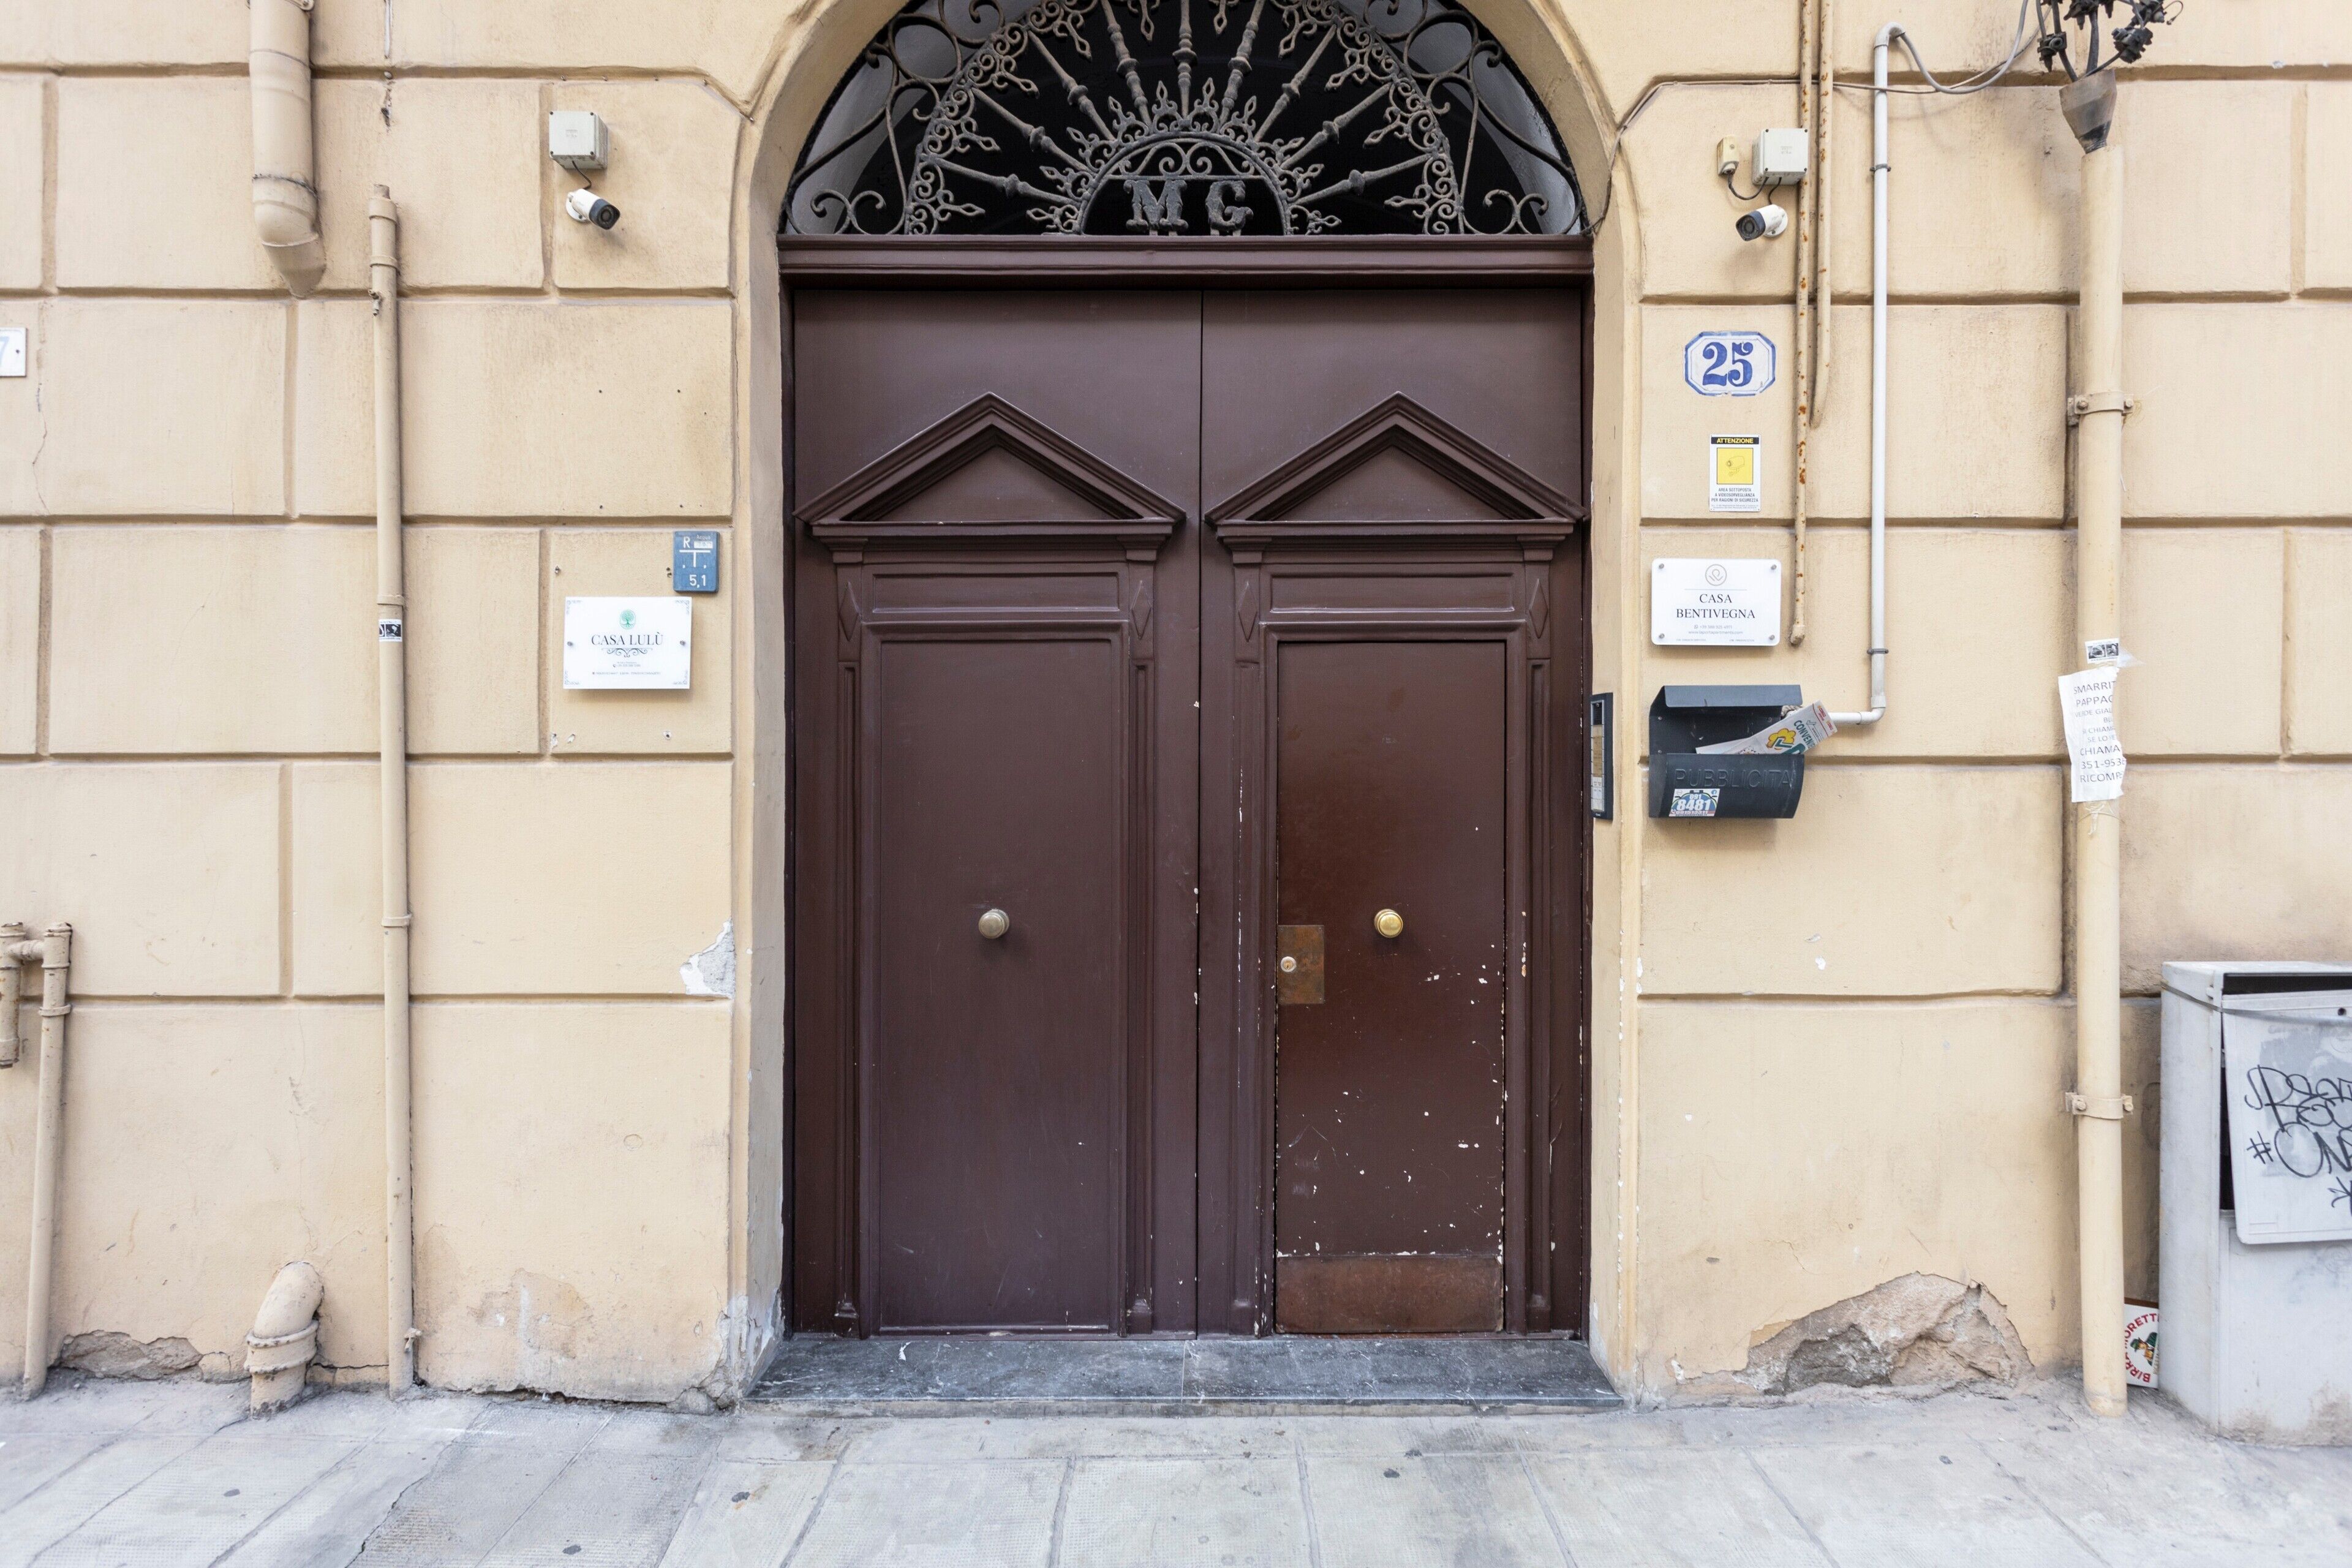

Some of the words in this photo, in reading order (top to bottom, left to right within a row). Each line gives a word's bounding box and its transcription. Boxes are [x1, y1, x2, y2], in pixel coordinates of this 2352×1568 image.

[1703, 342, 1754, 387] 25
[683, 536, 691, 548] R
[689, 574, 706, 589] 5,1
[1699, 594, 1733, 603] CASA
[1676, 608, 1756, 619] BENTIVEGNA
[591, 634, 625, 646] CASA
[630, 631, 663, 646] LULÙ
[2080, 745, 2120, 756] CHIAMA
[1676, 799, 1711, 812] 8481
